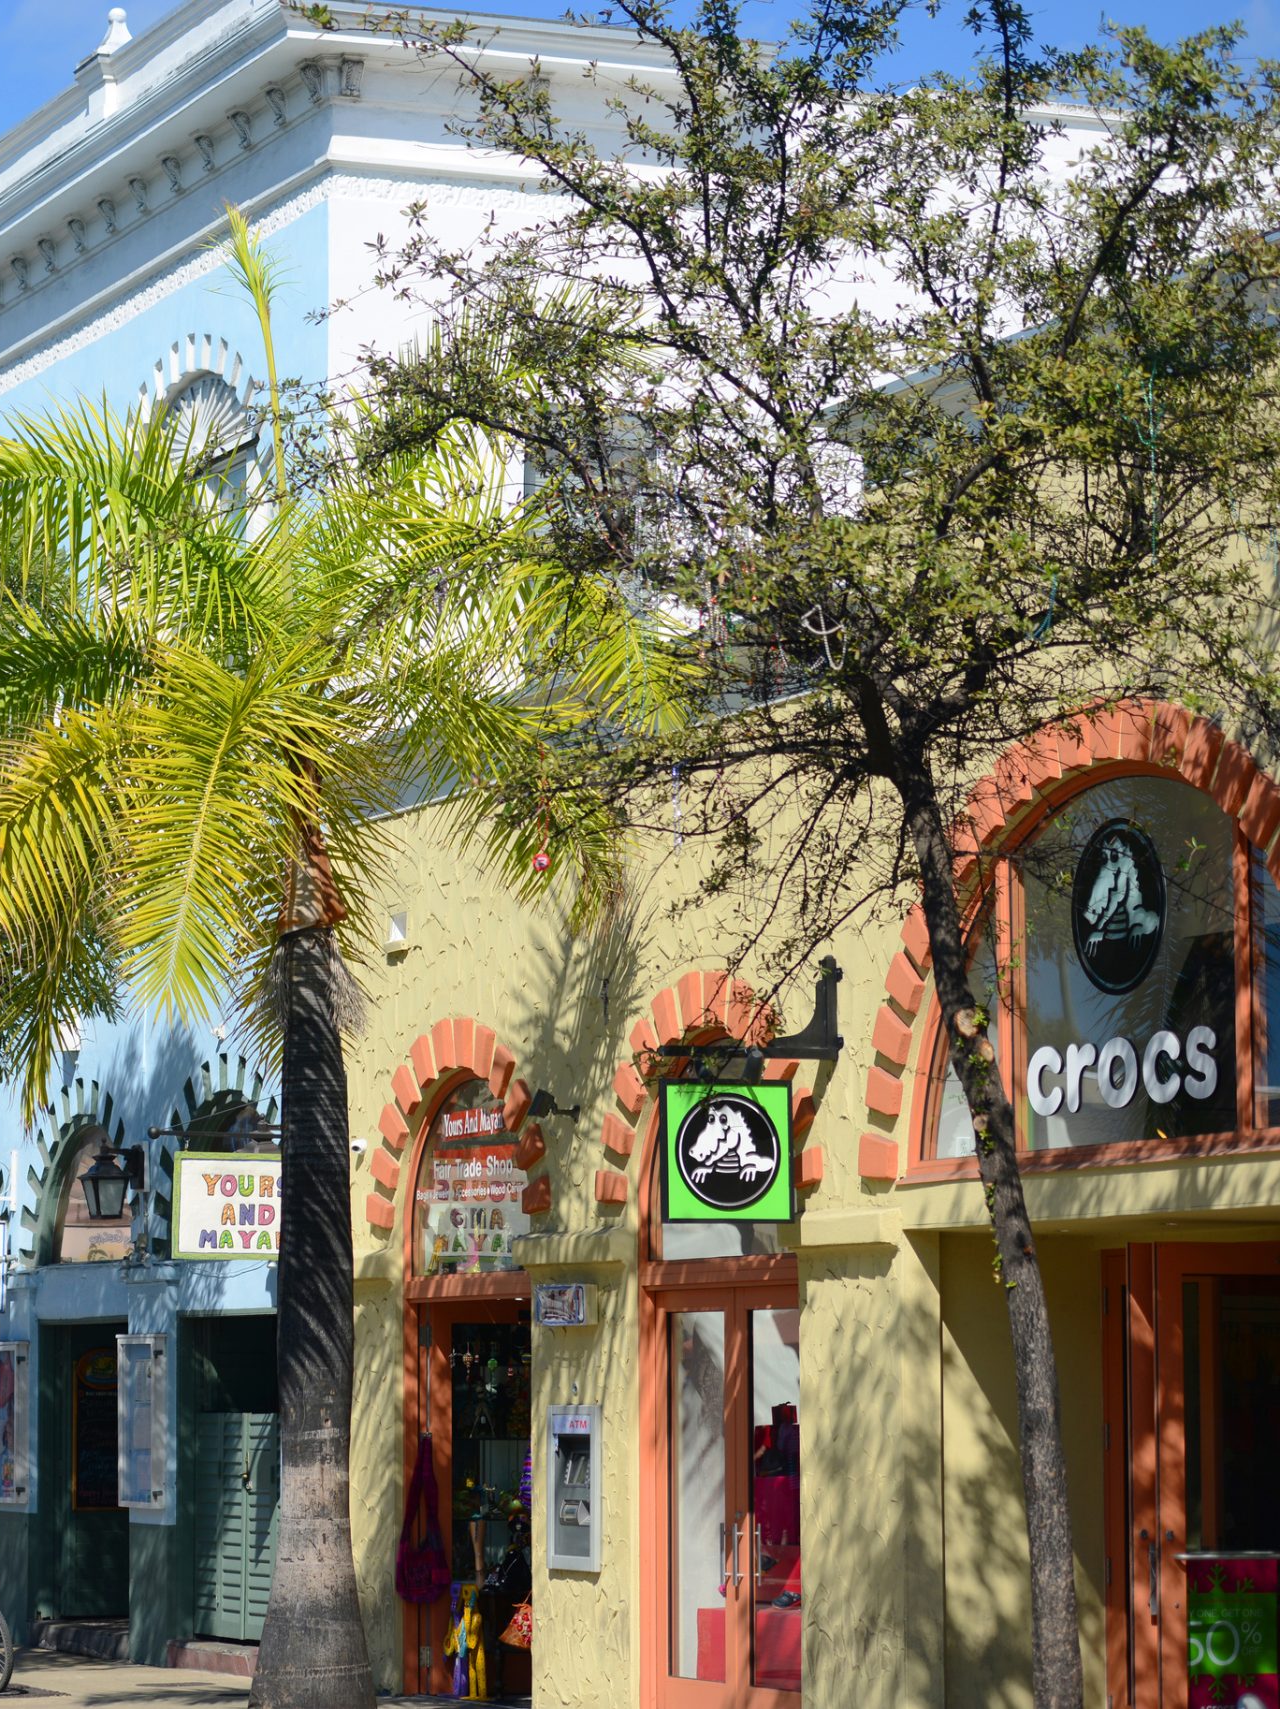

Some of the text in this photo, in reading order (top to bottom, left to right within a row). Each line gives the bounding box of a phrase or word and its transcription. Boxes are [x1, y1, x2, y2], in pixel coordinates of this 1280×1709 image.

[1026, 1025, 1218, 1117] crocs
[443, 1108, 504, 1137] Yours And Mayan
[433, 1154, 513, 1180] Fair Trade Shop
[221, 1203, 275, 1226] AND
[568, 1420, 587, 1429] ATM
